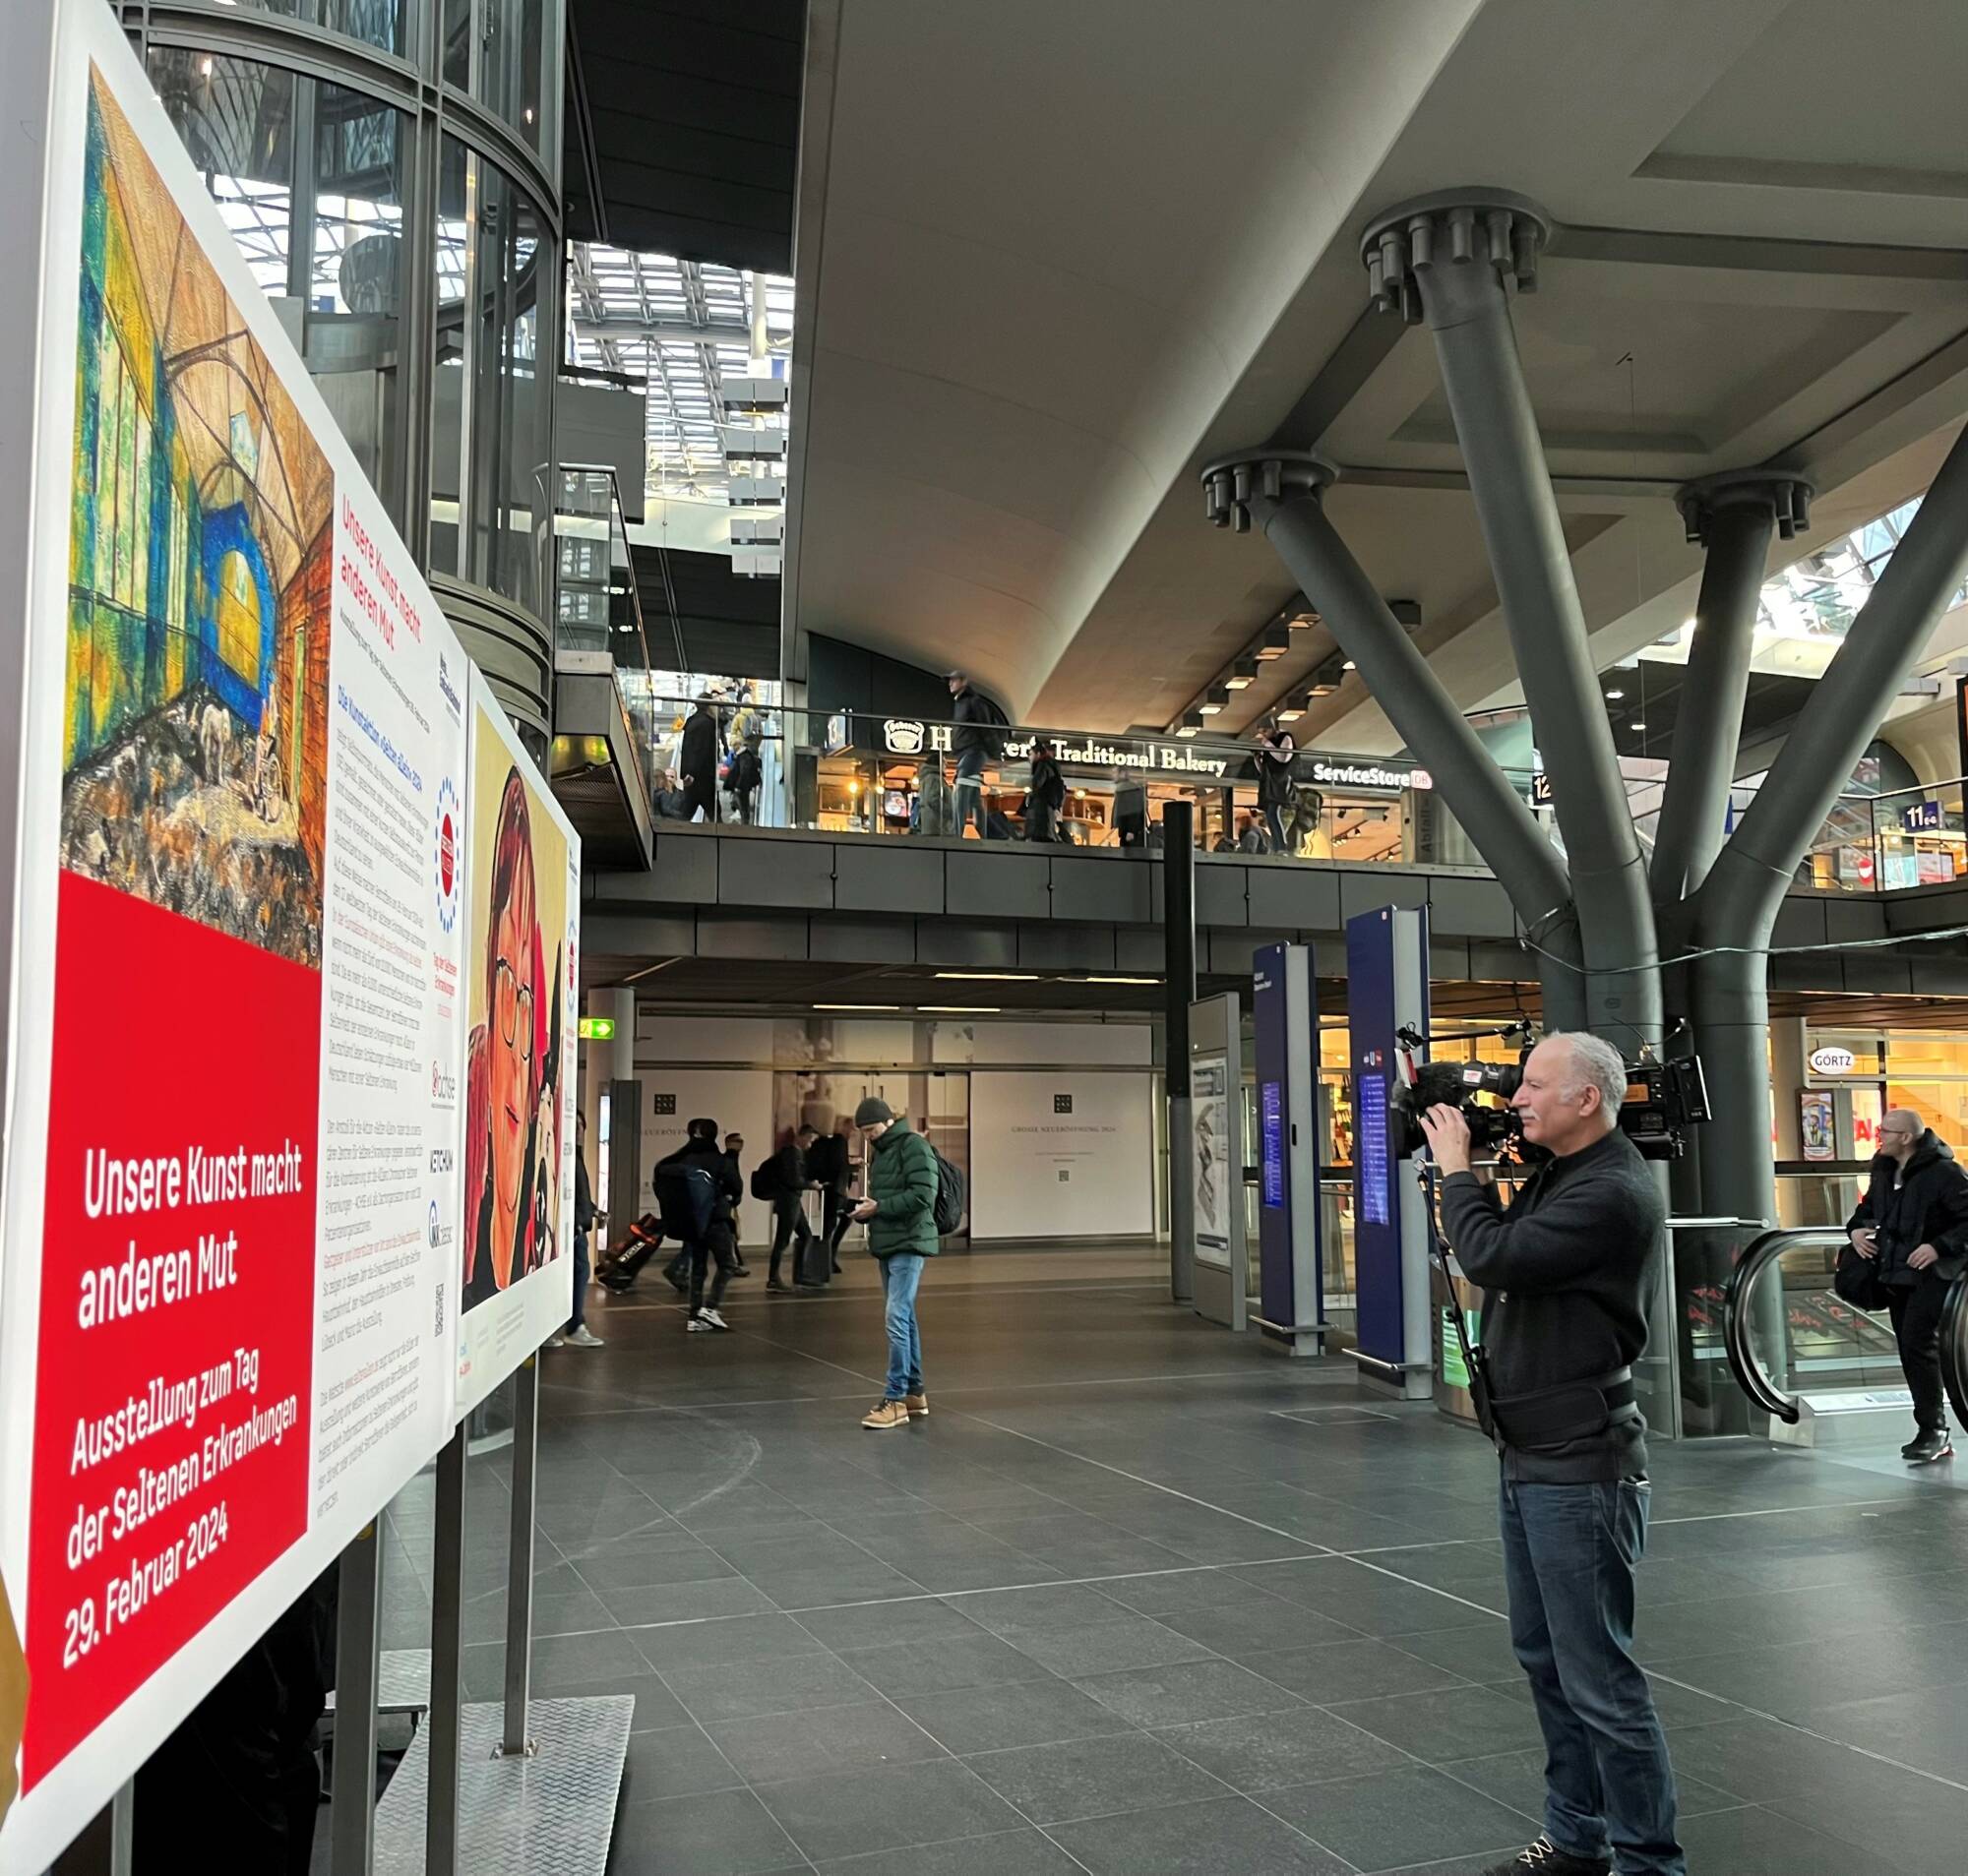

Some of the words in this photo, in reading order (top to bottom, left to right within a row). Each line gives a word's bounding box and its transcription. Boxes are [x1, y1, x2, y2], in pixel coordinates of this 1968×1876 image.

[341, 554, 378, 627] anderen
[379, 603, 395, 651] Mut
[342, 493, 374, 569] Unsere
[376, 546, 399, 608] Kunst
[400, 592, 421, 643] macht
[1050, 739, 1155, 767] Traditional
[1161, 748, 1228, 778] Bakery
[1314, 762, 1410, 787] ServiceStore
[1534, 775, 1552, 799] 12
[1907, 805, 1924, 827] 11
[1814, 1054, 1851, 1066] GÖRTZ
[85, 1147, 181, 1219] Unsere
[186, 1145, 248, 1205] Kunst
[251, 1137, 302, 1197] macht
[429, 1149, 453, 1174] KETCHUM
[78, 1240, 192, 1329] anderen
[197, 1230, 238, 1295] Mut
[70, 1376, 198, 1476] Ausstellung
[200, 1361, 232, 1409] zum
[234, 1347, 260, 1394] Tag
[67, 1503, 109, 1570] der
[111, 1467, 199, 1542] Seltenen
[203, 1393, 298, 1483] Erkrankungen
[62, 1597, 100, 1669] 29.
[104, 1539, 185, 1636] Februar
[186, 1499, 229, 1571] 2024
